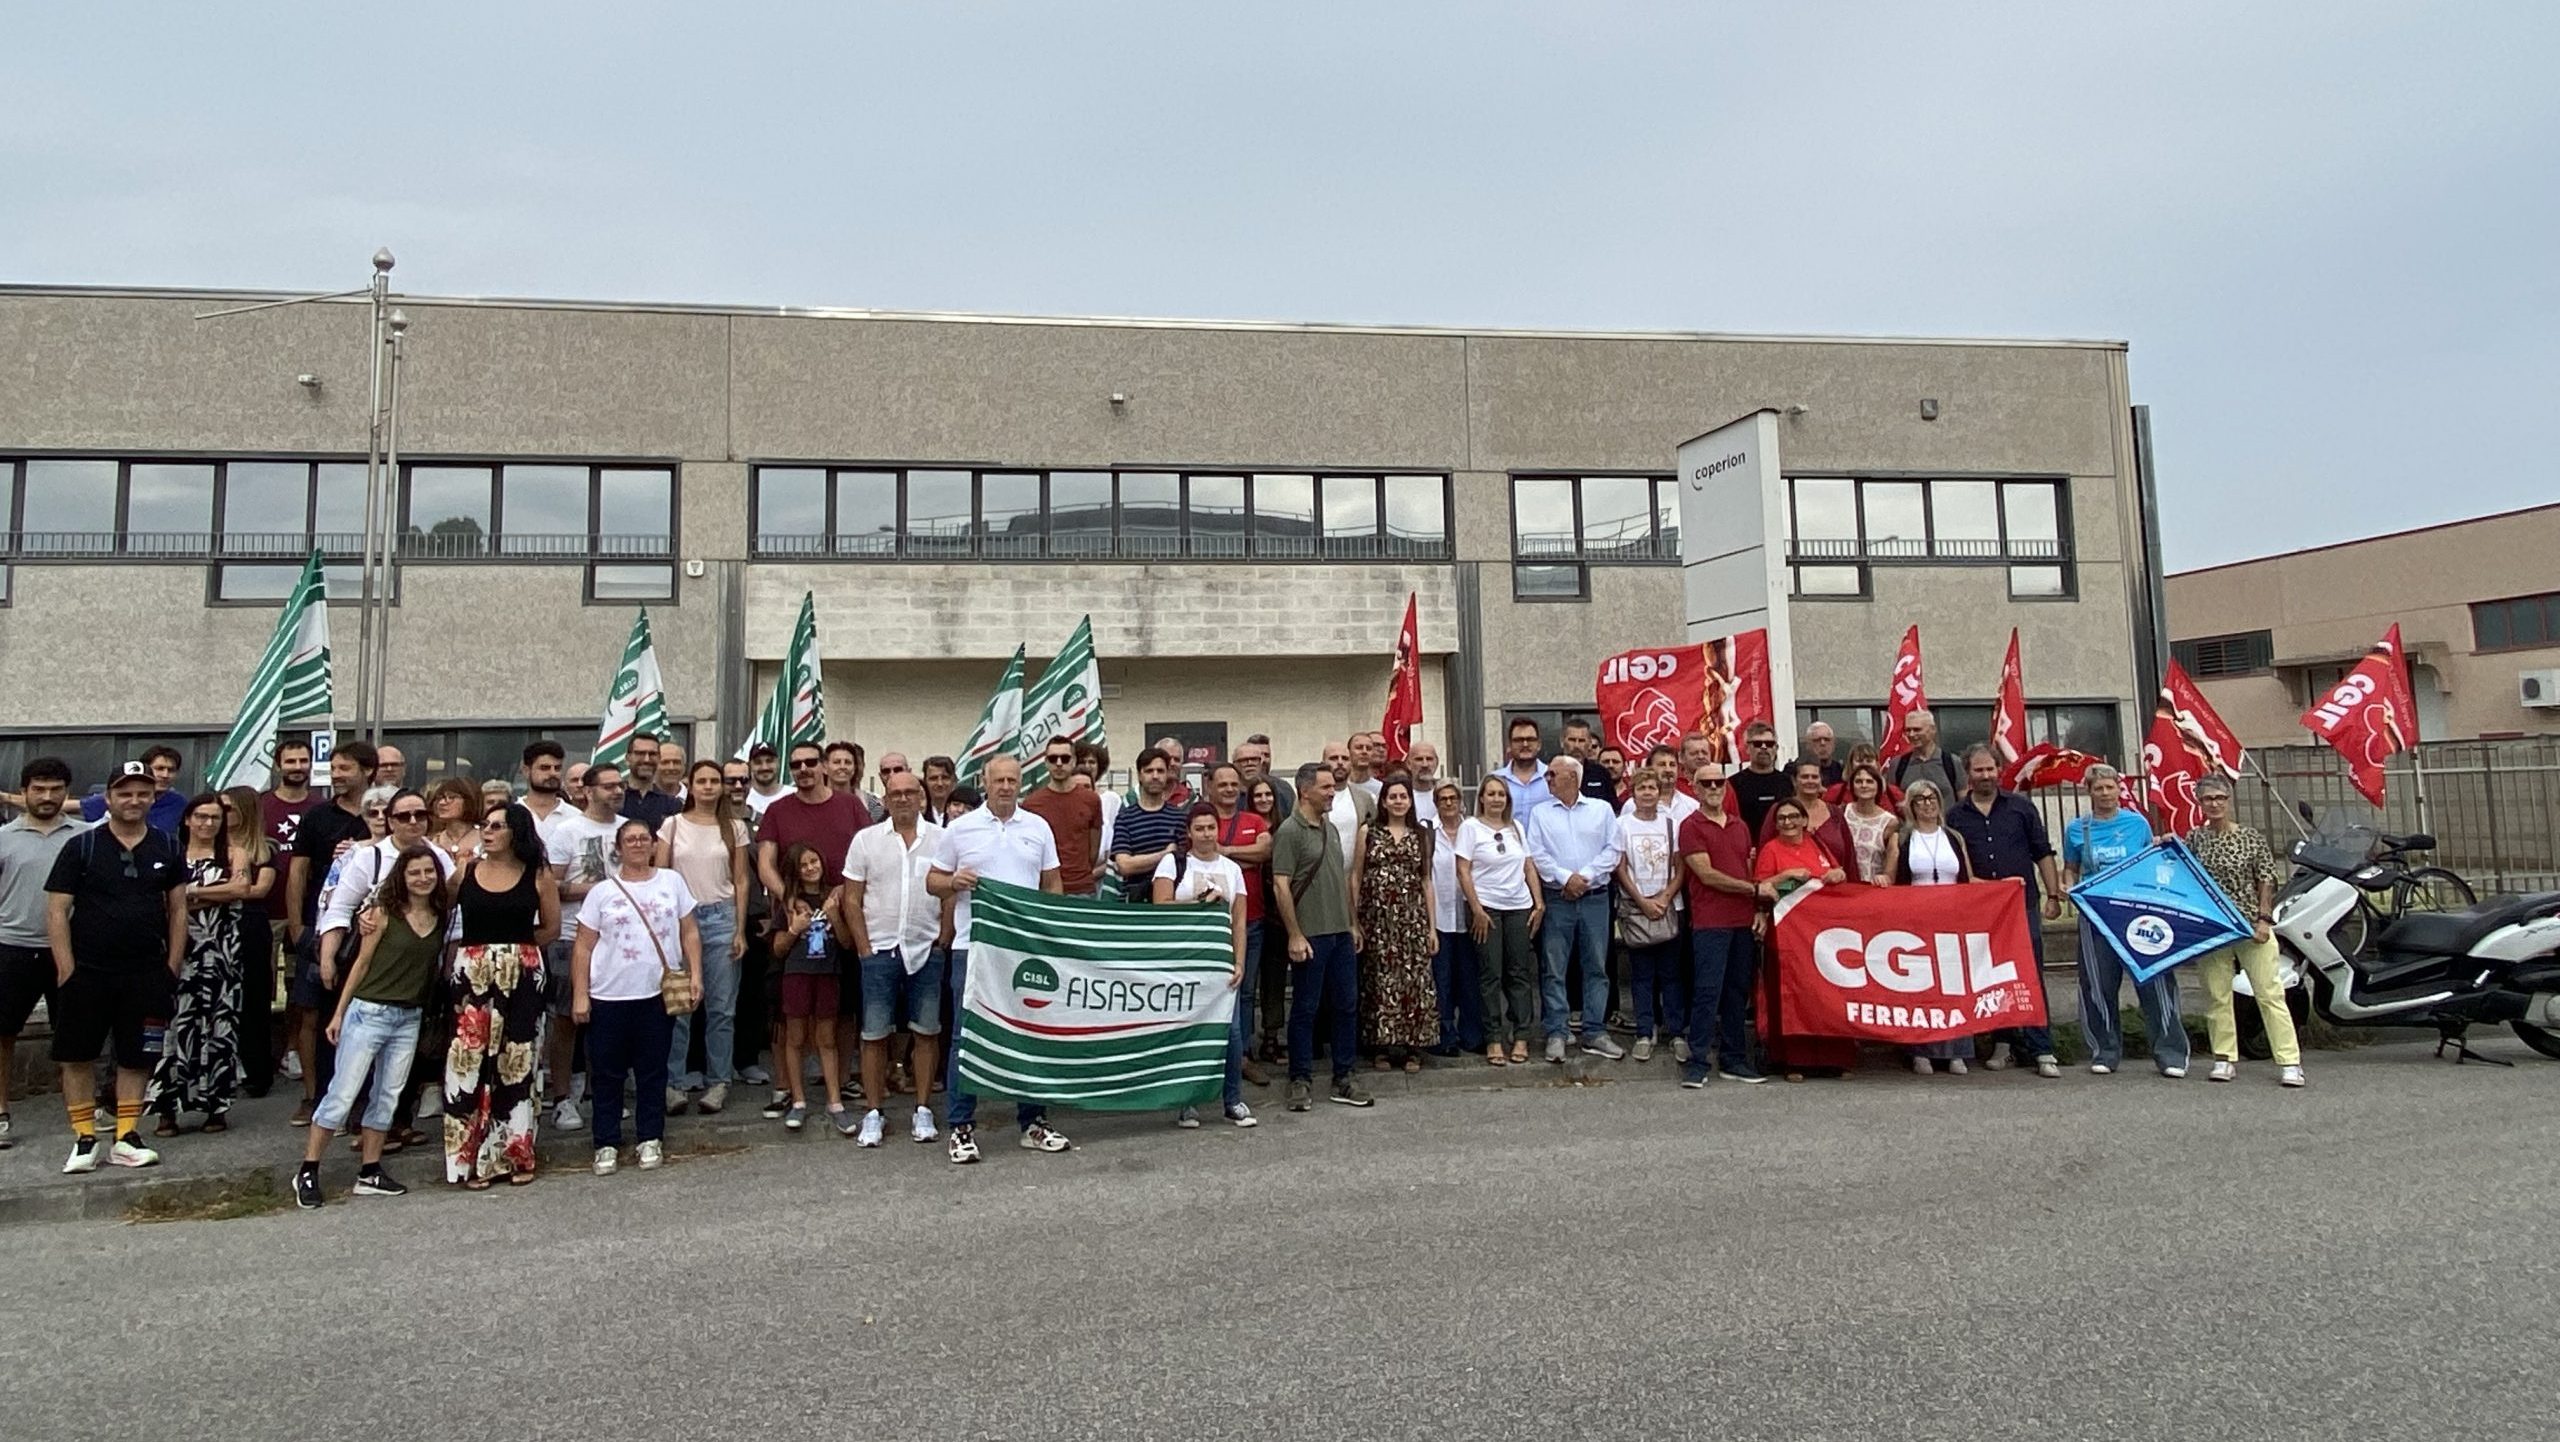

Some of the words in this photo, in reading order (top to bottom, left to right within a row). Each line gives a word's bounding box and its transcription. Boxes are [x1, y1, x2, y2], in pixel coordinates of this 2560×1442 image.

[1695, 452, 1746, 480] coperion
[317, 738, 330, 760] P
[1813, 927, 2019, 995] CGIL
[1022, 971, 1050, 986] CISL
[1066, 976, 1201, 1012] FISASCAT
[1846, 1001, 1967, 1029] FERRARA
